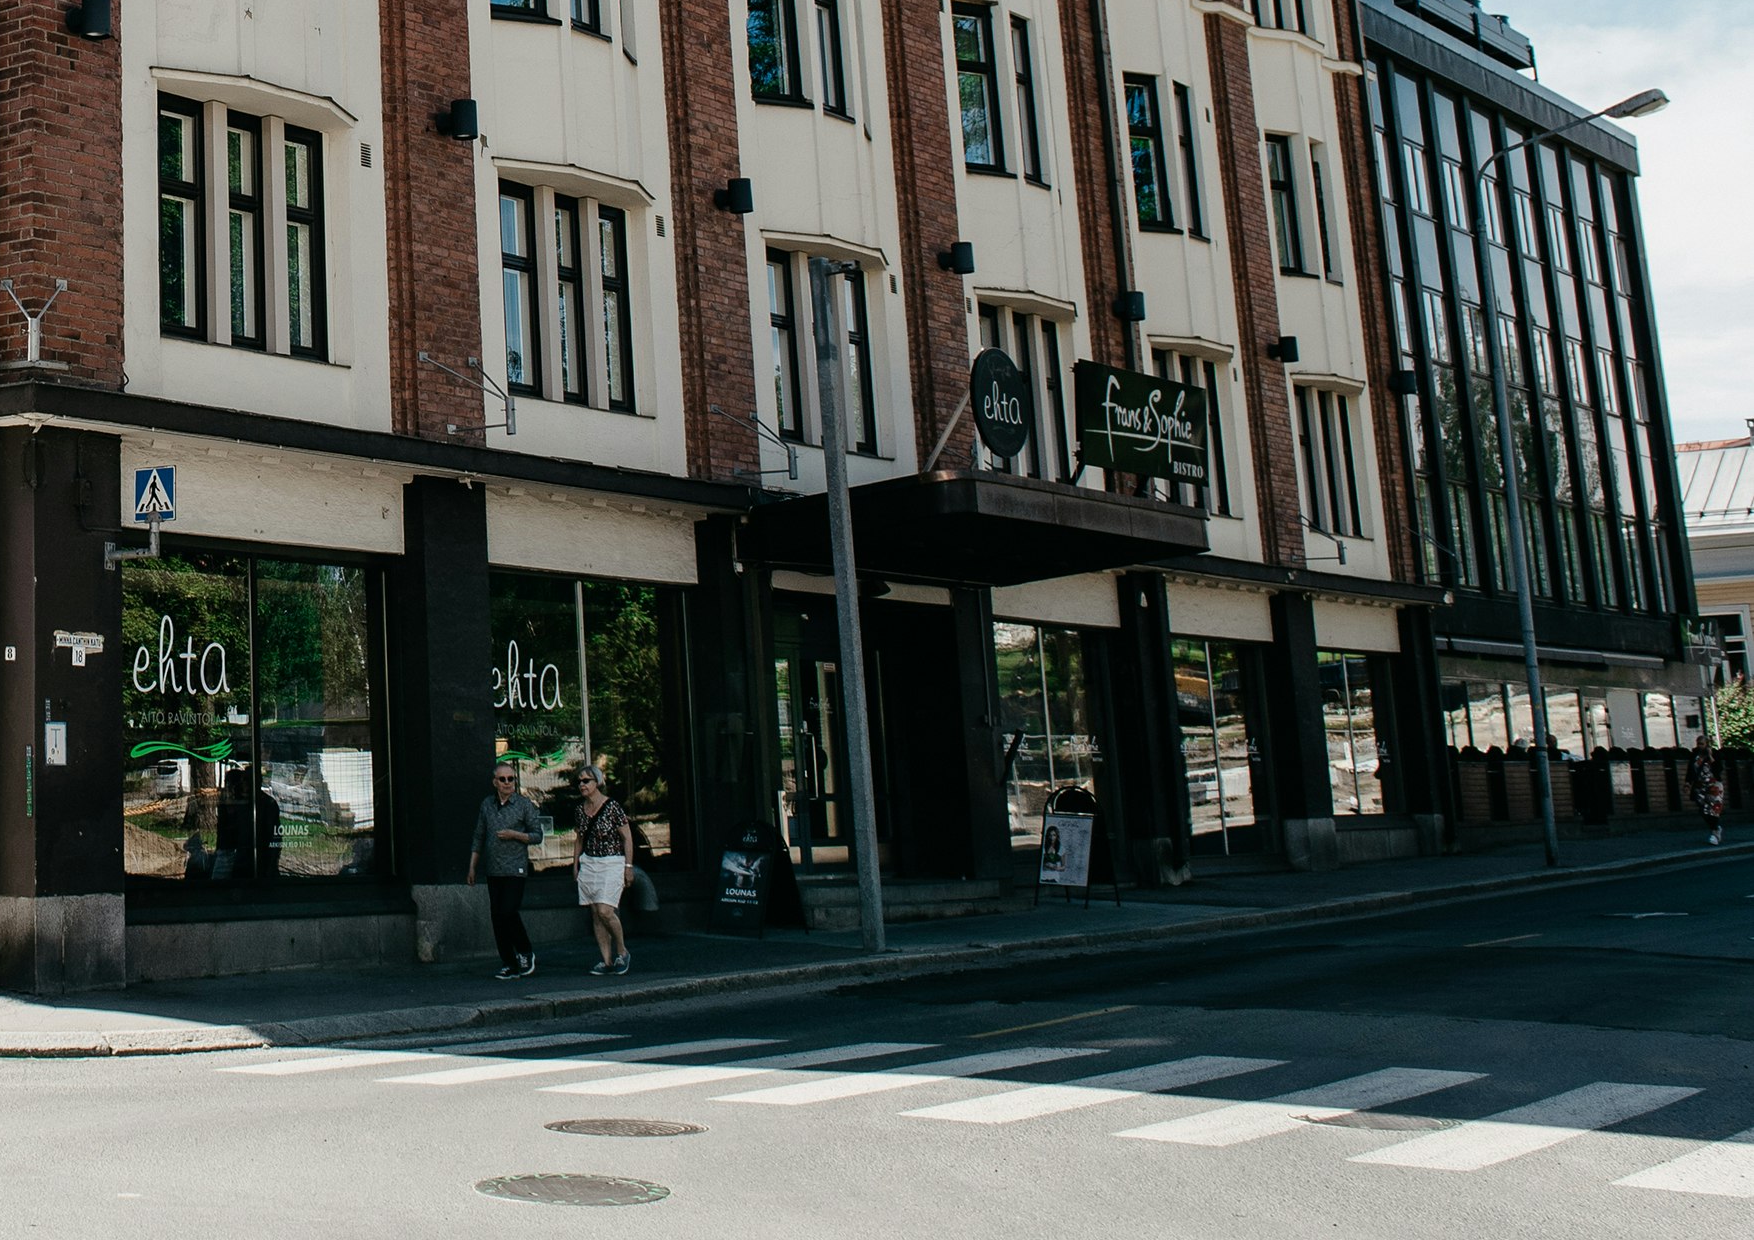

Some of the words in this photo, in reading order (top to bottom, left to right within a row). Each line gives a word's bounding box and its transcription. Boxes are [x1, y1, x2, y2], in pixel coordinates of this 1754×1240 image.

[984, 381, 1023, 424] ehta
[1173, 461, 1204, 478] BISTRO
[7, 648, 13, 659] 8
[75, 650, 83, 662] 18
[133, 615, 230, 694] ehta
[141, 712, 165, 724] AITO
[273, 825, 309, 836] LOUNAS
[726, 887, 757, 897] LOUNAS
